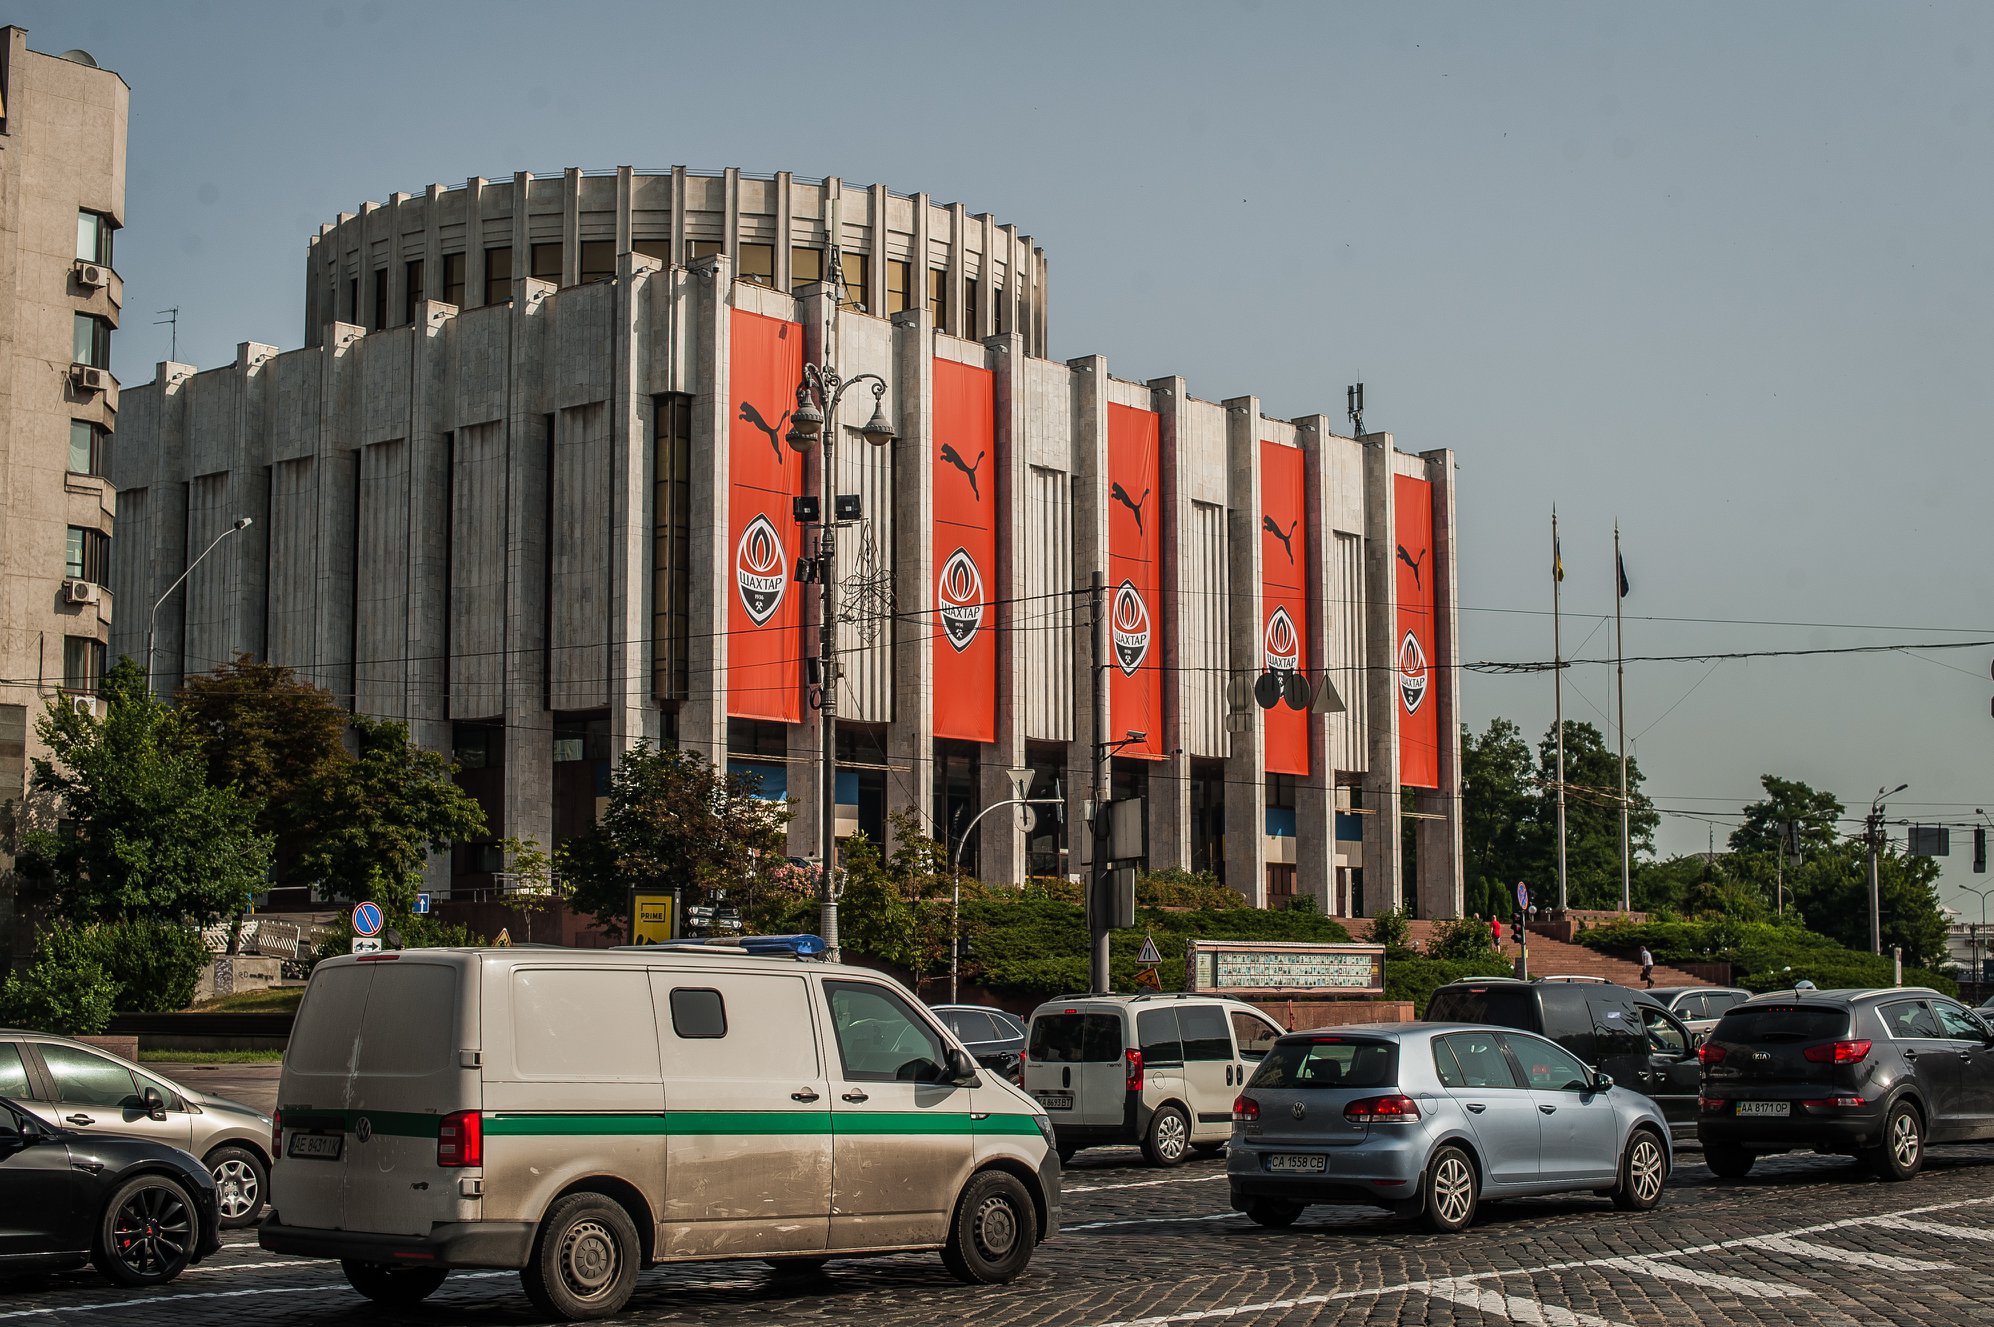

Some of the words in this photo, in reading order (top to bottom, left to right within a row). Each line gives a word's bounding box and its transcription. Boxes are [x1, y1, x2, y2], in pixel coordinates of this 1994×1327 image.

[740, 571, 782, 590] ШАХТАР
[941, 601, 980, 619] ШАХТАР
[1114, 629, 1147, 646] ШАХТАР
[1267, 653, 1296, 668] ШАХТАР
[641, 912, 663, 920] PRIME
[1742, 1103, 1753, 1113] AA
[1755, 1103, 1774, 1113] 8171
[1775, 1103, 1788, 1113] OP
[294, 1137, 306, 1152] AE
[307, 1138, 327, 1153] 8431
[1272, 1156, 1285, 1168] CA
[1287, 1156, 1308, 1168] 1558
[1309, 1157, 1324, 1168] CB
